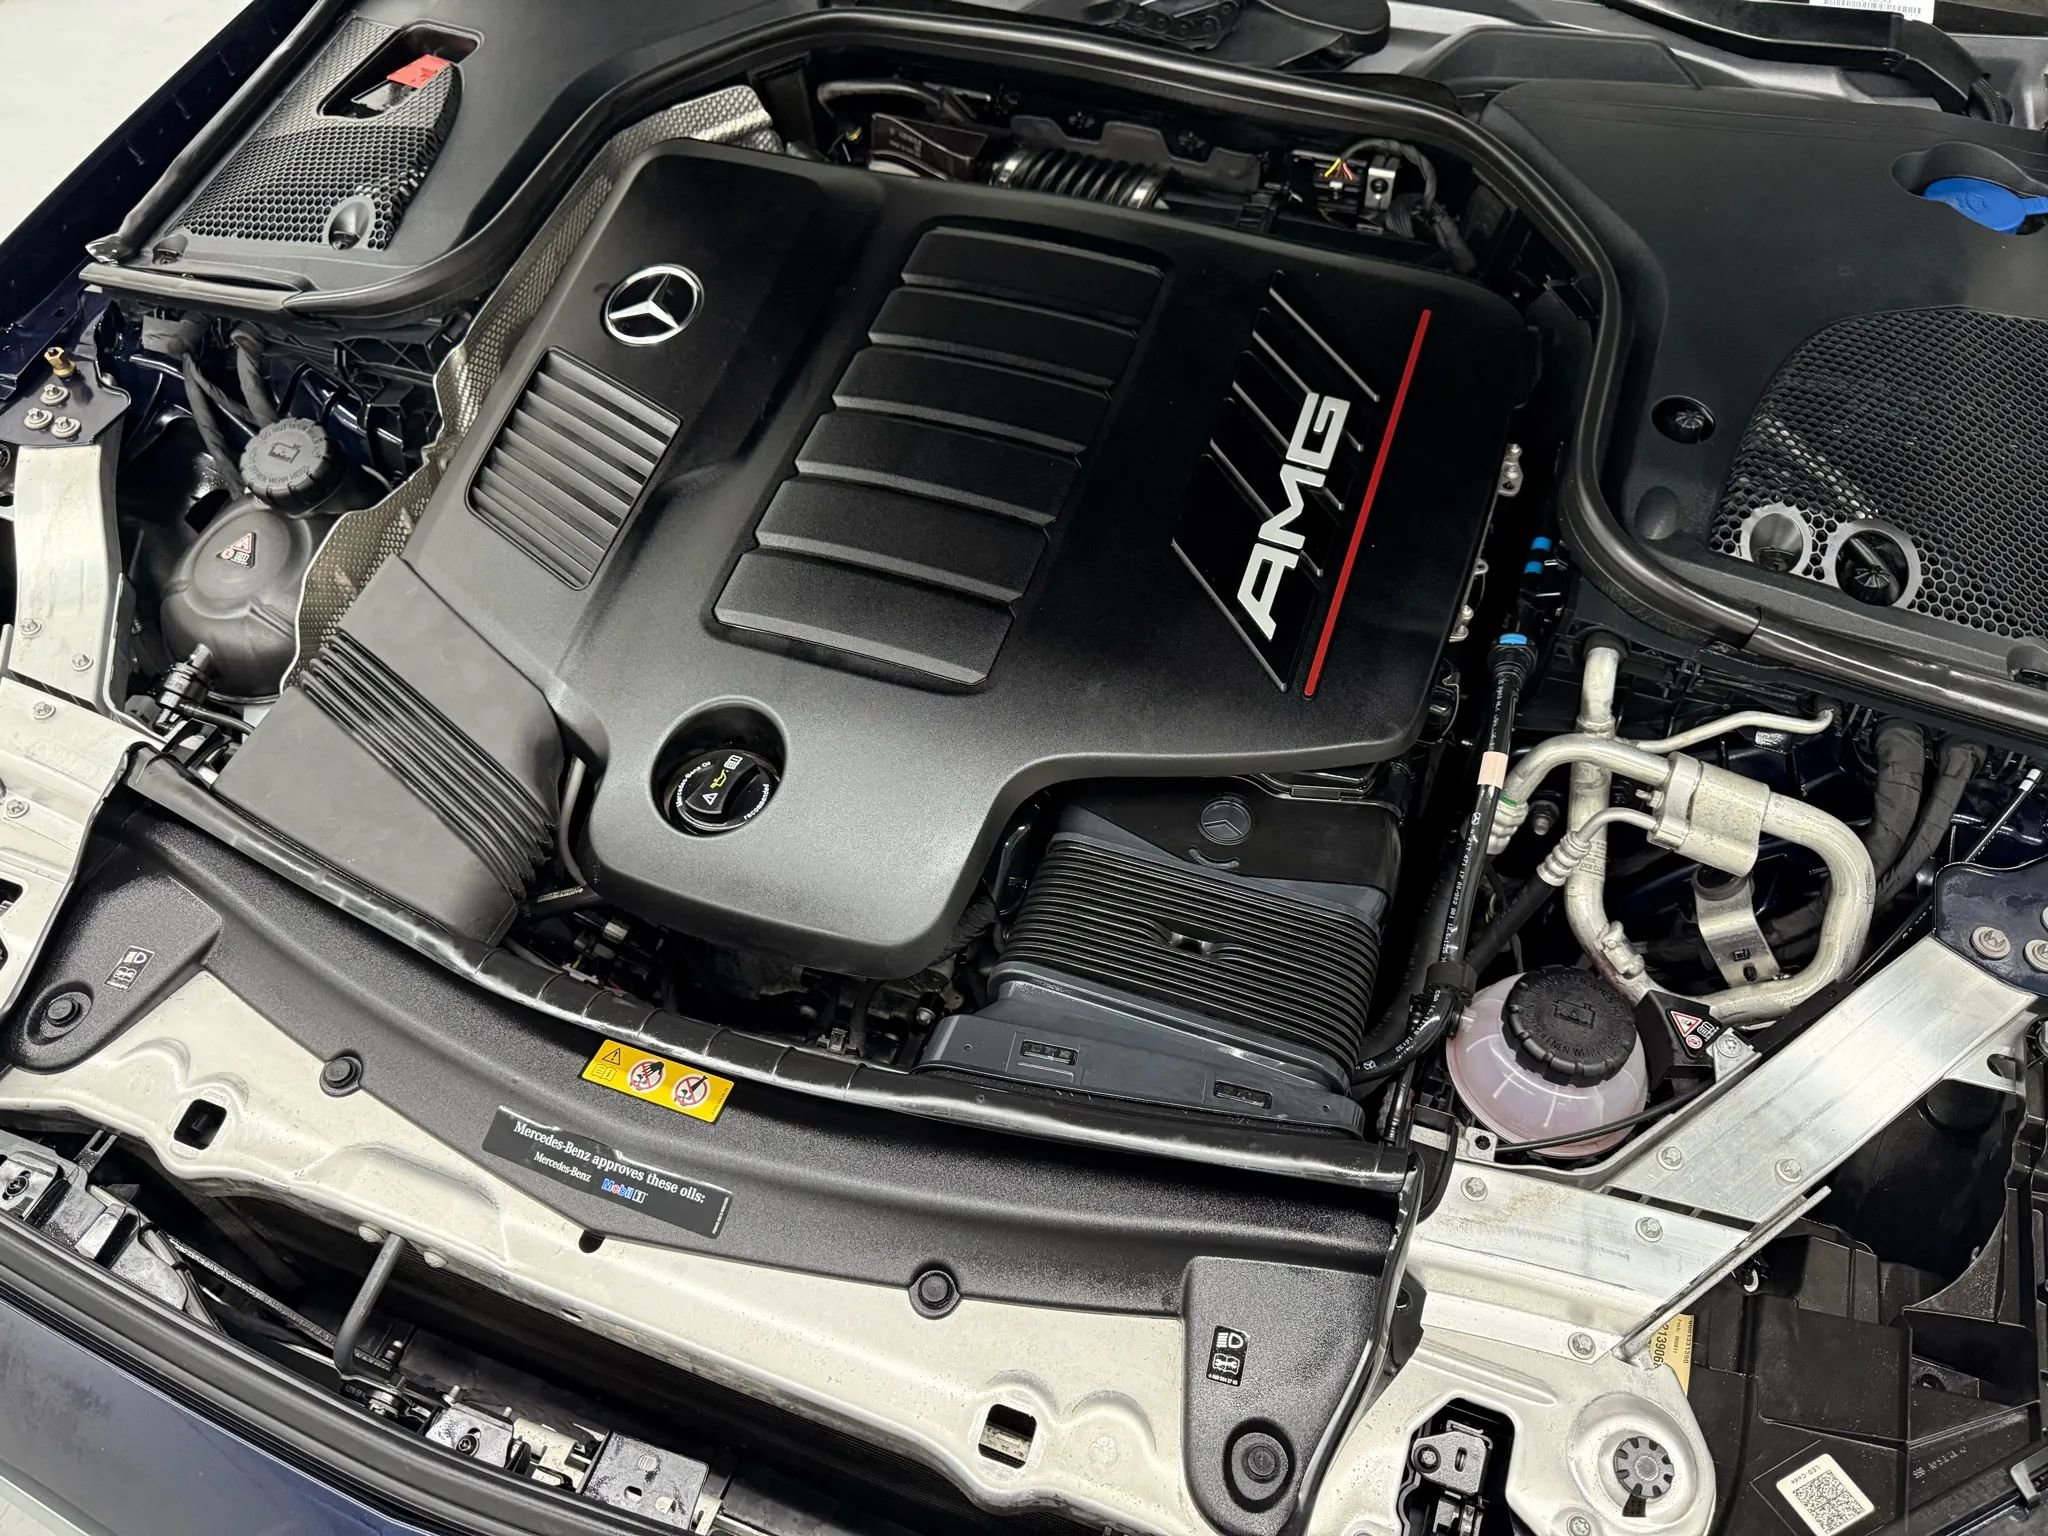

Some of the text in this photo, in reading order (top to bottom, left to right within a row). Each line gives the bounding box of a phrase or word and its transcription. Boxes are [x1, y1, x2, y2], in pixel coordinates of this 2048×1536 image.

[1237, 392, 1350, 641] AMG
[513, 1120, 706, 1204] Mercedes-Benz approves these oils:
[533, 1151, 592, 1183] Mercedes-Benz
[601, 1177, 635, 1200] Mobil
